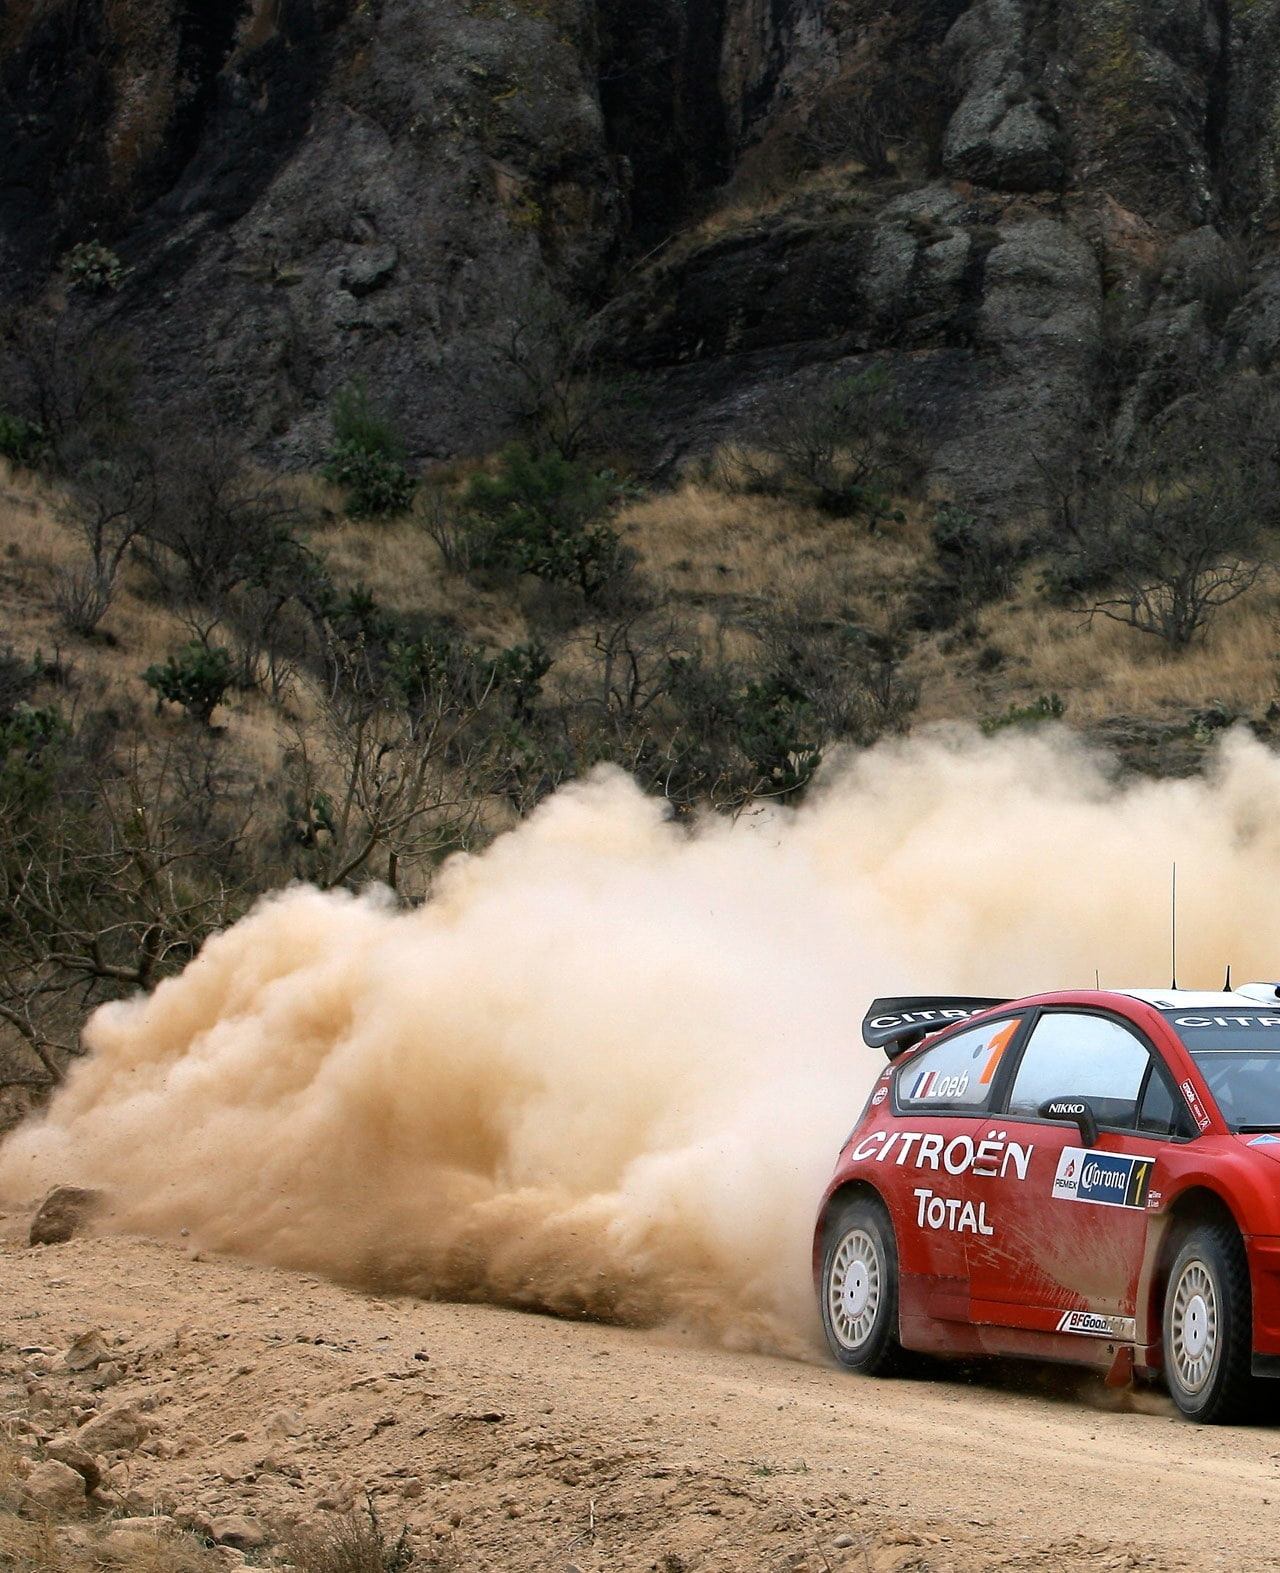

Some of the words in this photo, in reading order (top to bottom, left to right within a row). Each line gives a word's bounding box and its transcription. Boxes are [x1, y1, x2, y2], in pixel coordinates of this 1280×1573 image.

[978, 1019, 1022, 1085] 1
[926, 1069, 969, 1098] Loeb
[1048, 1103, 1085, 1114] NIKKO
[852, 1130, 1034, 1180] CITROËN
[1055, 1178, 1078, 1190] PEMEX
[1081, 1162, 1125, 1192] Corona
[1135, 1162, 1148, 1205] 1
